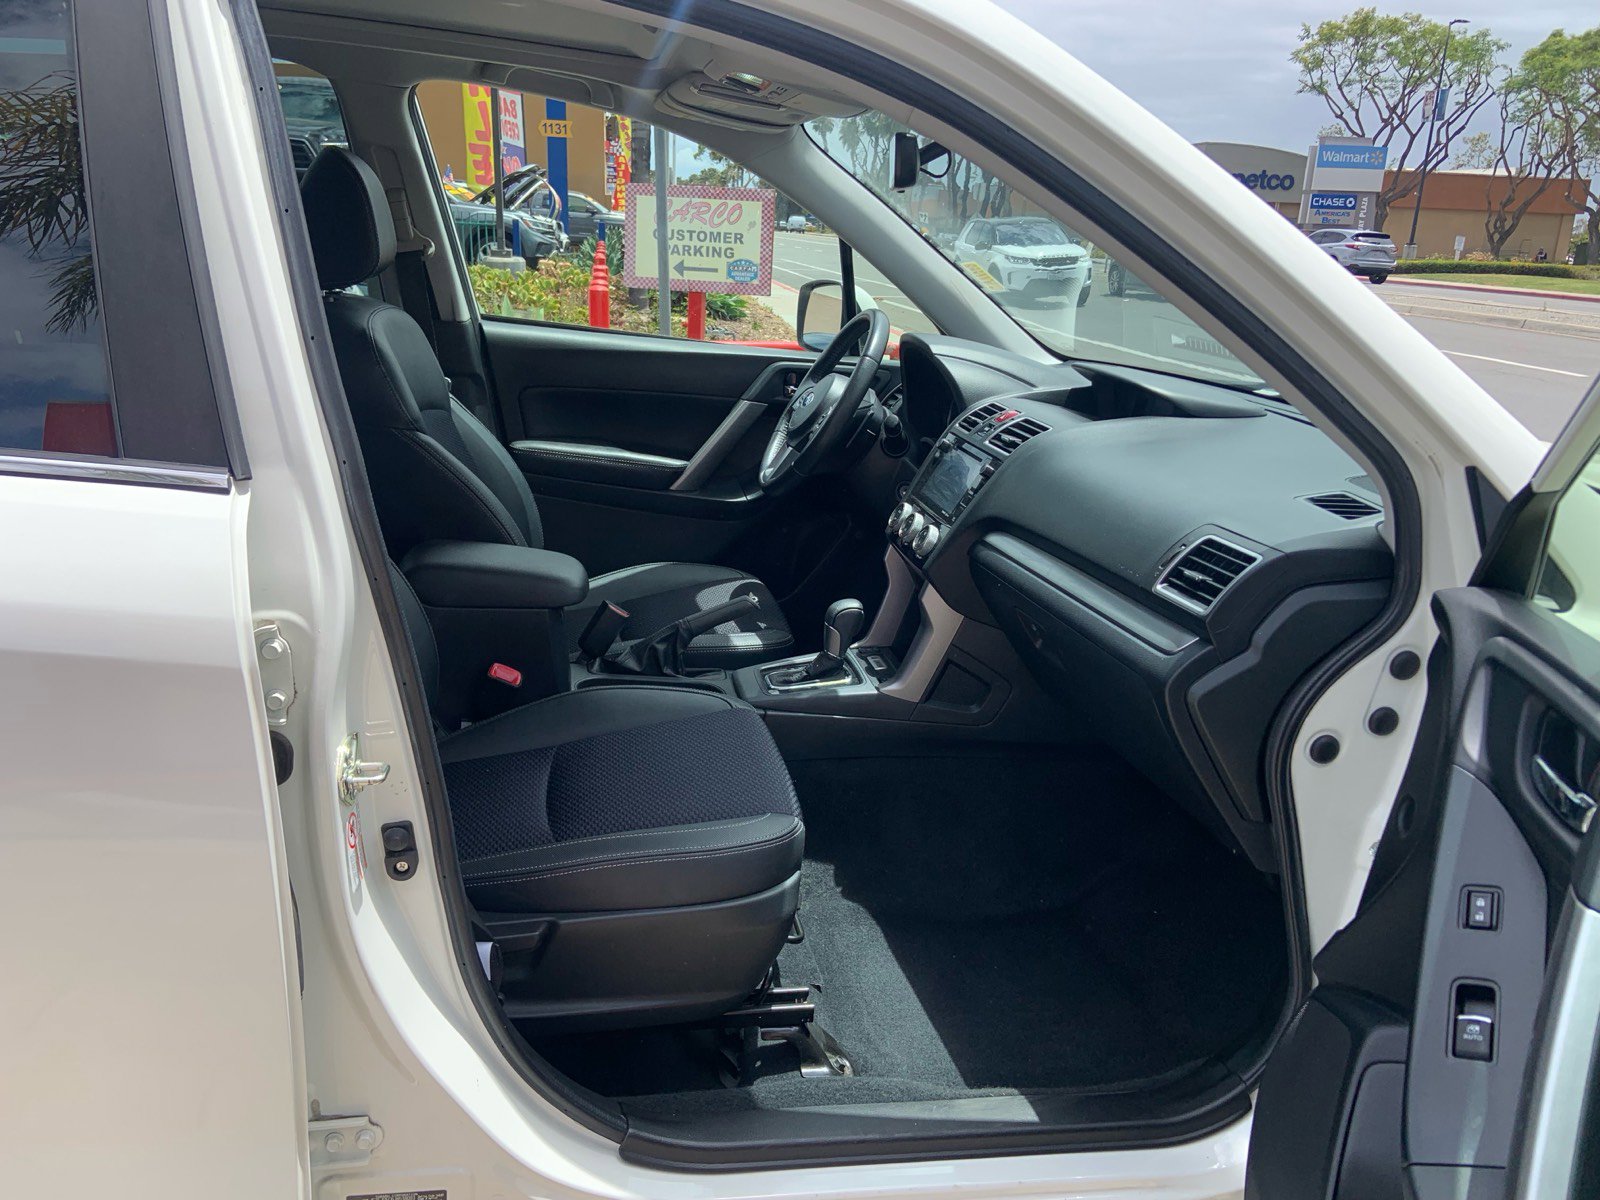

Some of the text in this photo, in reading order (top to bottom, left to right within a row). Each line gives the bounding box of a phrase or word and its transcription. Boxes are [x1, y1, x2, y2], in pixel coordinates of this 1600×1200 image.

[542, 122, 567, 135] 1131
[1322, 150, 1370, 163] Walmart
[1312, 197, 1345, 206] CHASE
[1360, 196, 1369, 217] PLAZA
[668, 244, 735, 259] ARKING
